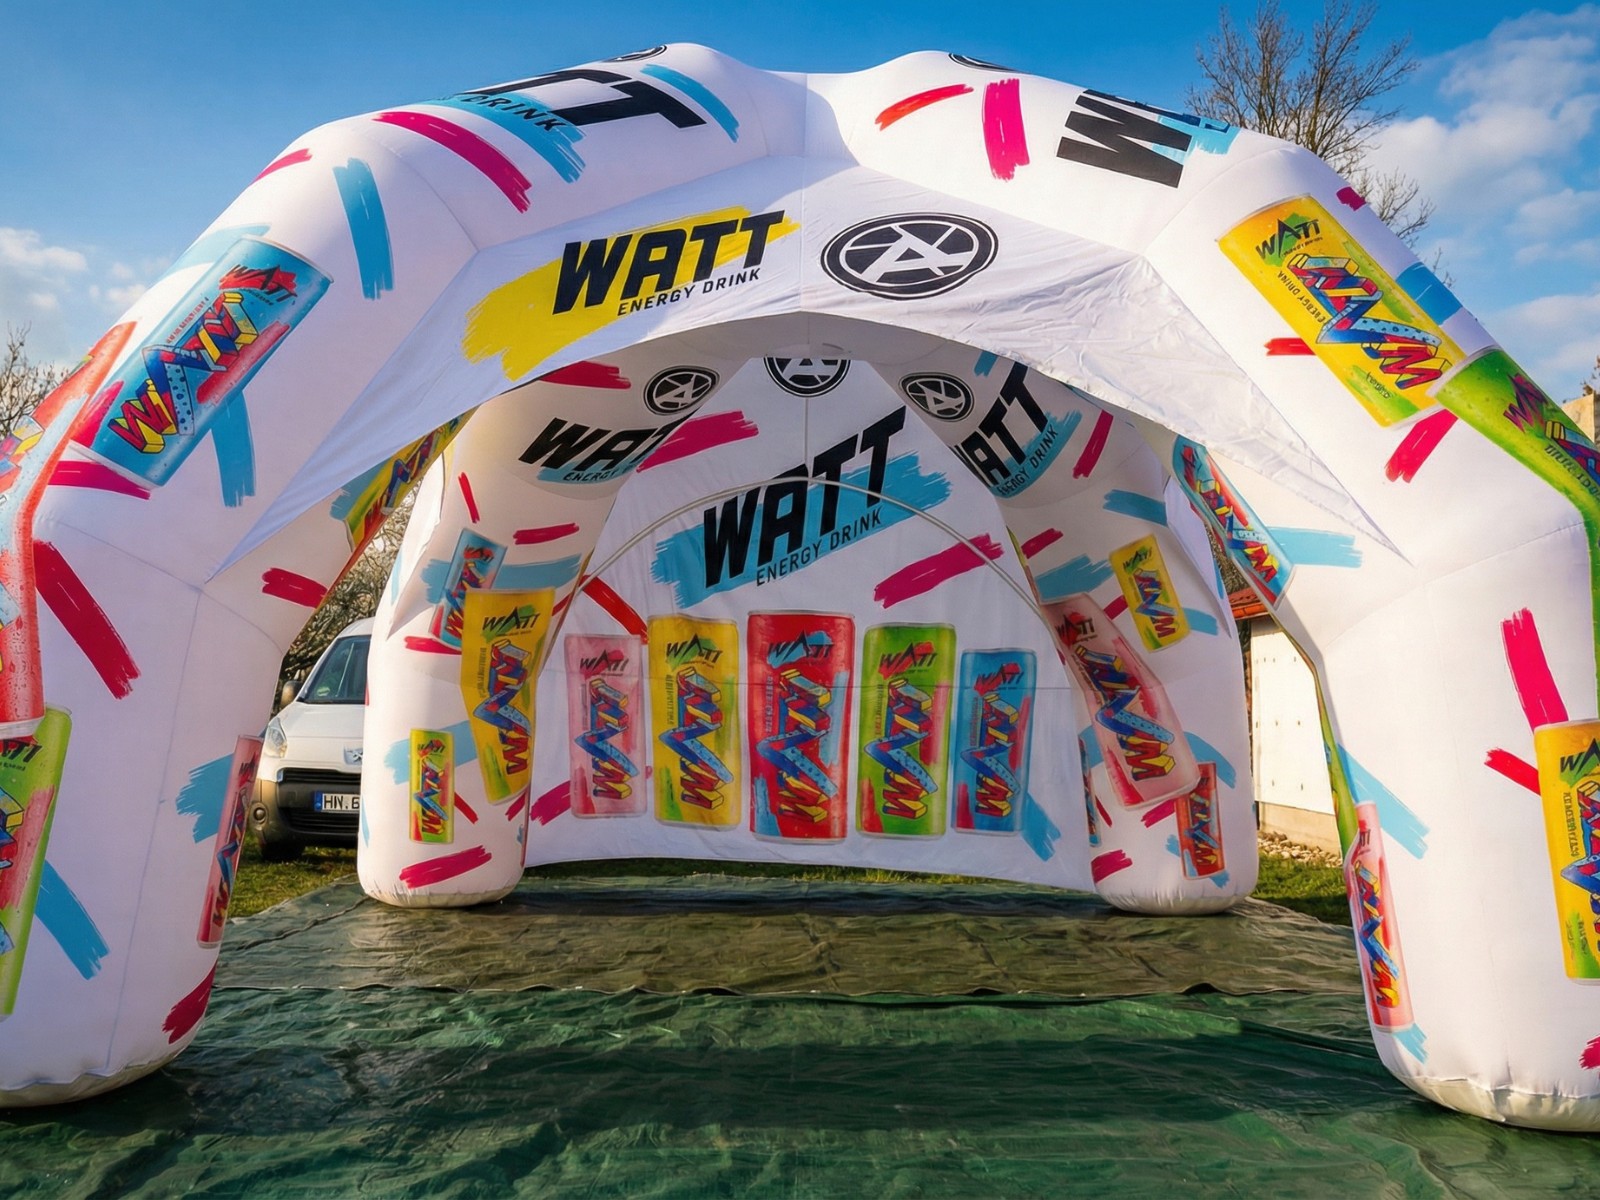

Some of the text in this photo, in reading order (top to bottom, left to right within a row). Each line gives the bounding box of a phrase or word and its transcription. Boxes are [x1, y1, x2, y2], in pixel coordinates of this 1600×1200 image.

[552, 210, 785, 315] WATT
[617, 268, 761, 316] ENERGY DRINK
[518, 408, 698, 471] WAT
[1029, 424, 1059, 469] DRINK
[704, 405, 906, 589] WATT
[756, 507, 882, 587] ENERGY DRINK
[666, 634, 723, 663] WATT
[879, 643, 938, 669] WATT
